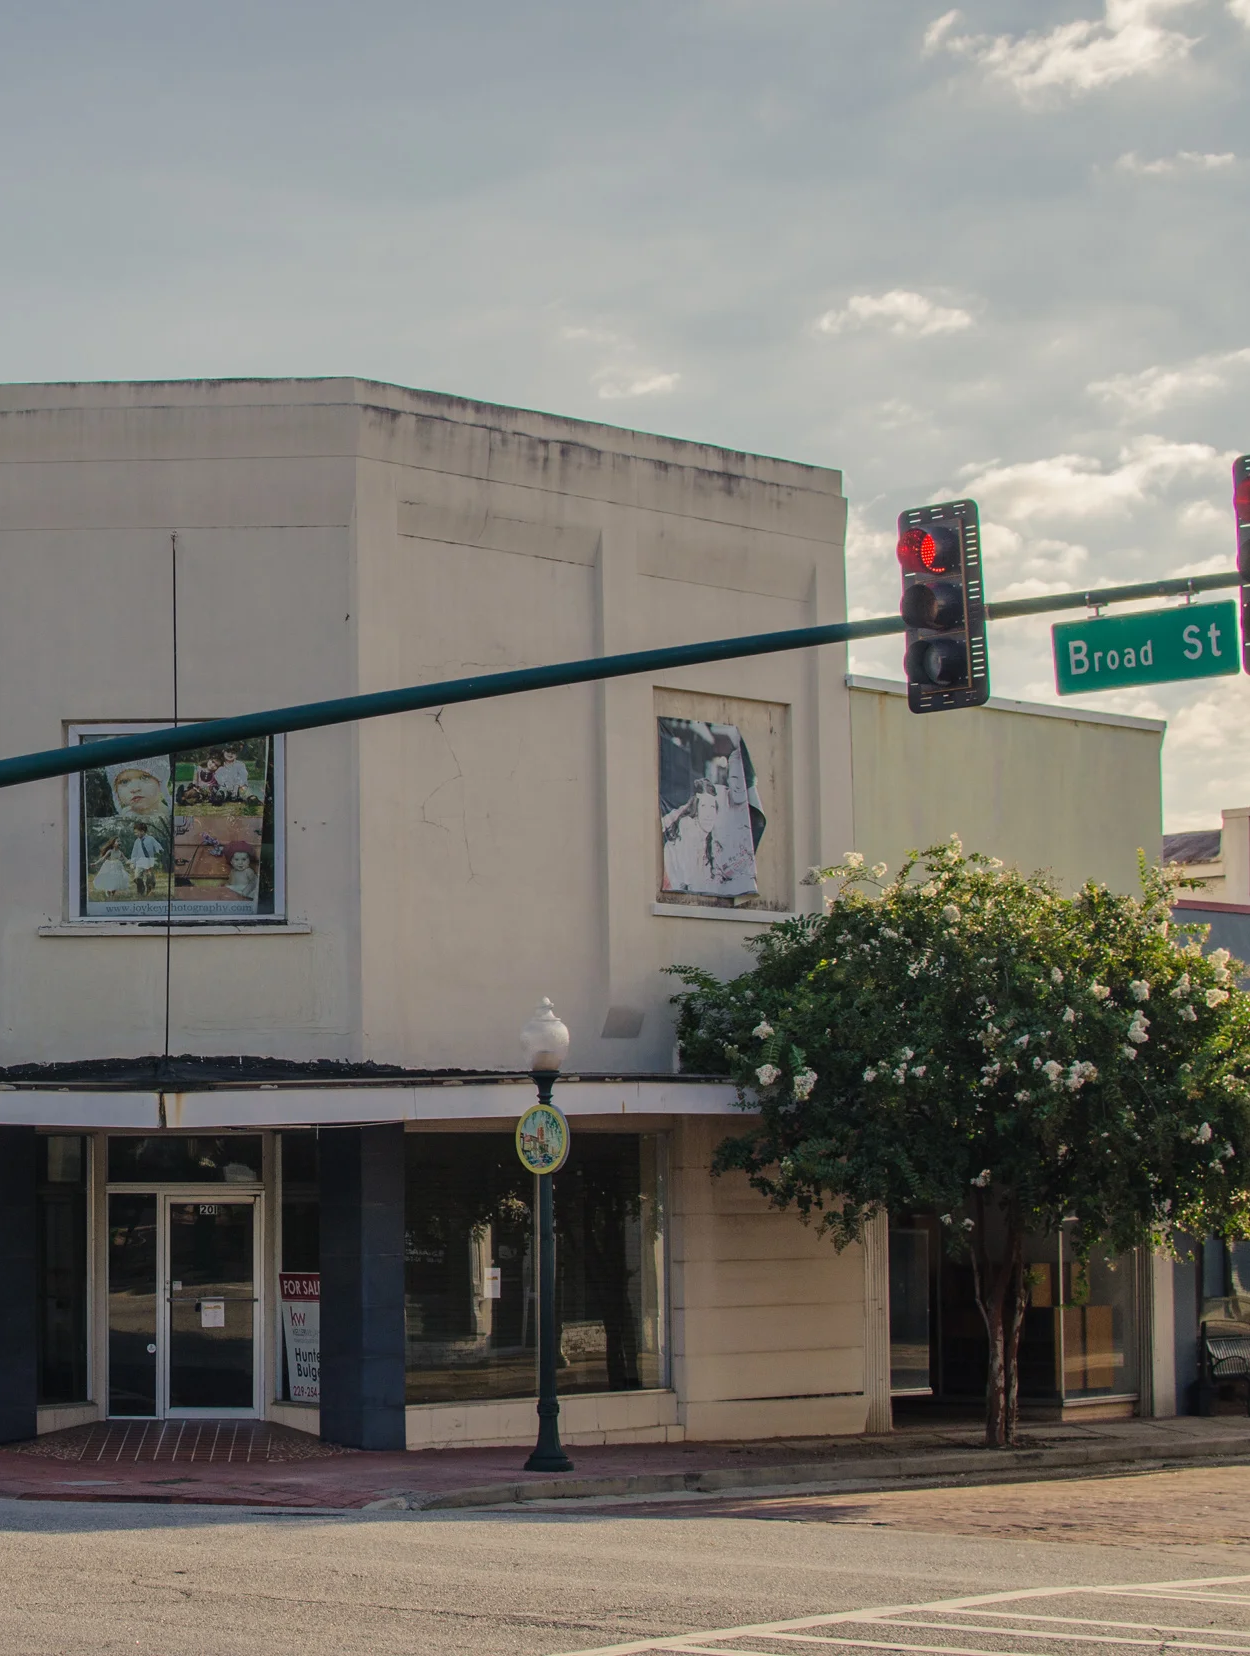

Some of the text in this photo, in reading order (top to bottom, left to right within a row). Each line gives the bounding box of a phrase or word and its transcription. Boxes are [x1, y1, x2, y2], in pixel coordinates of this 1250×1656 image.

[1068, 622, 1222, 675] Broad St
[105, 903, 253, 915] www.joykeyphotography.com
[200, 1205, 217, 1214] 201
[283, 1280, 301, 1295] FOR
[295, 1347, 320, 1362] Hunte
